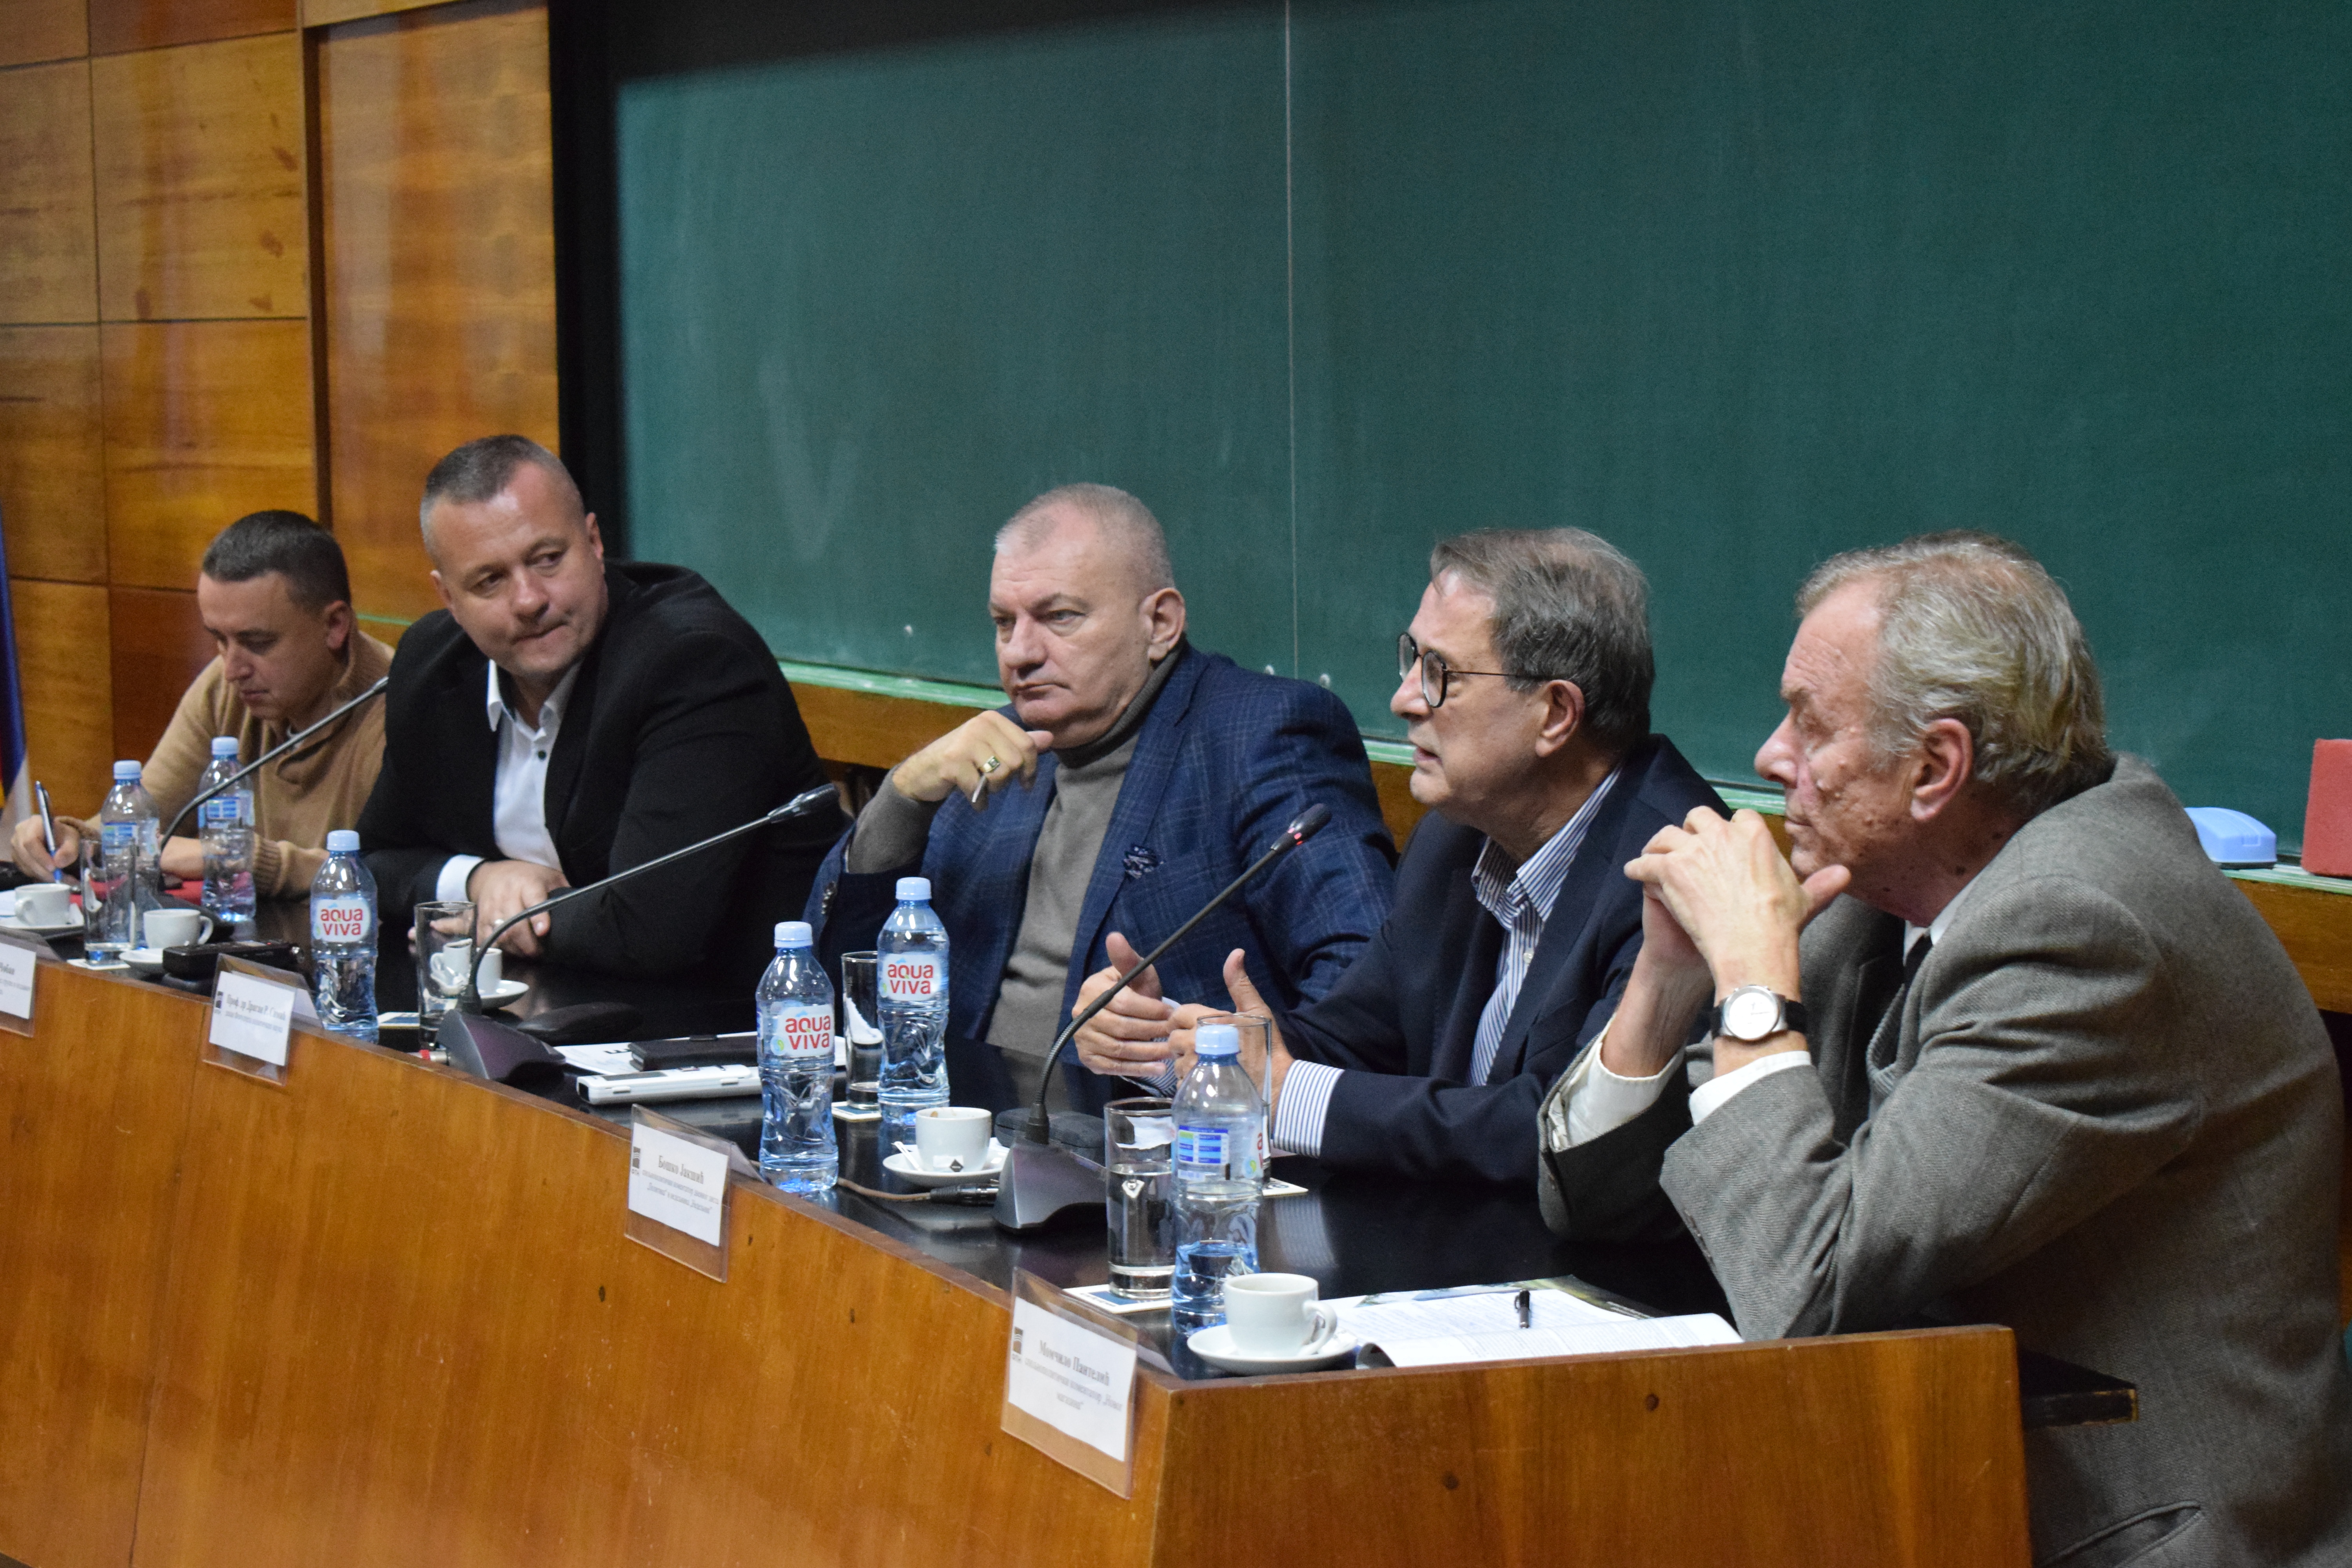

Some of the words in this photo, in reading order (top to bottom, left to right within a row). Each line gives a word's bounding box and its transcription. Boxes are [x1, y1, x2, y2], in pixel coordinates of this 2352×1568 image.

[320, 908, 363, 922] aqua
[323, 923, 361, 936] viva
[887, 964, 933, 979] aqua
[890, 980, 931, 995] viva
[785, 1015, 831, 1033] aqua
[788, 1033, 830, 1050] viva
